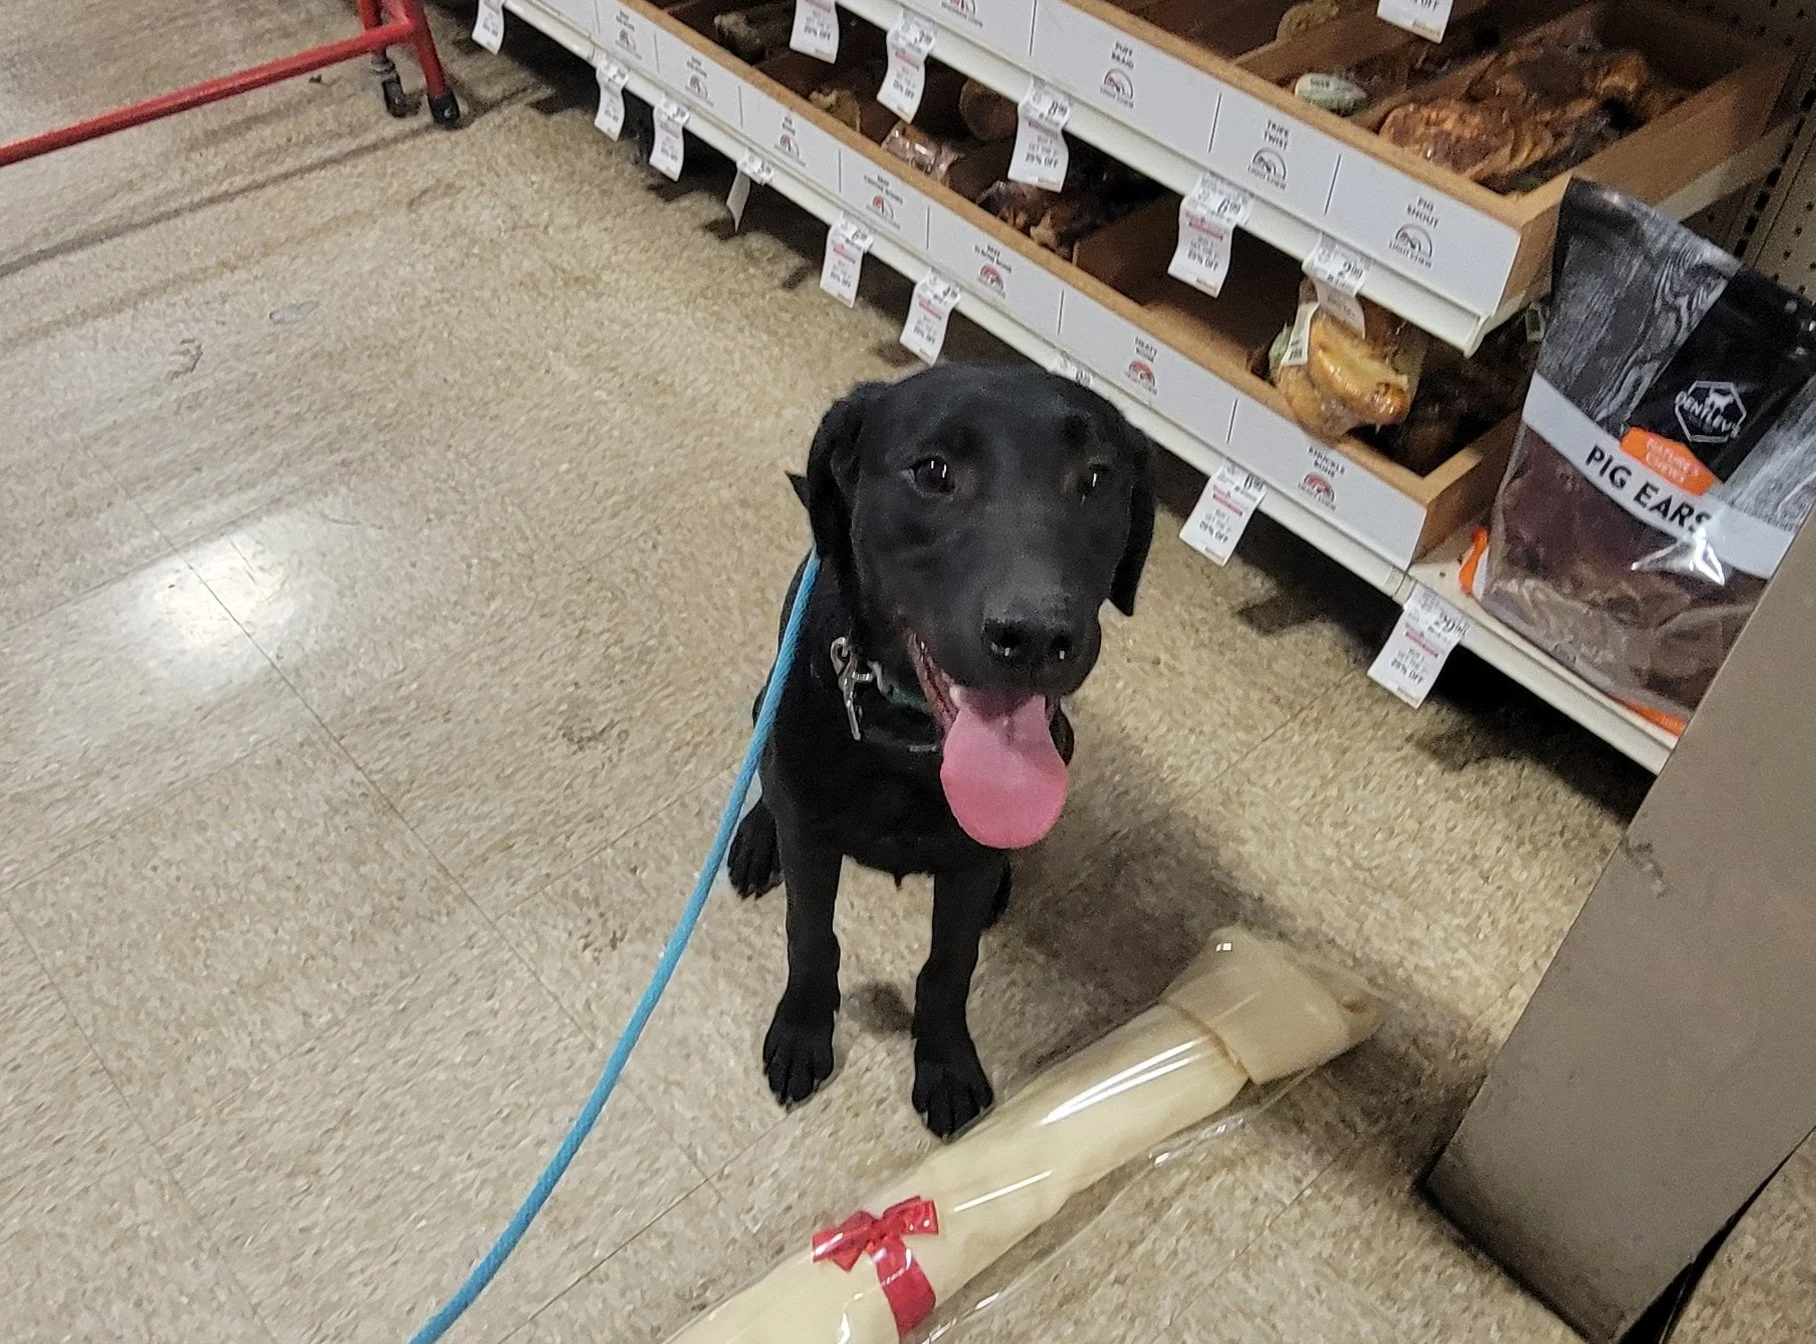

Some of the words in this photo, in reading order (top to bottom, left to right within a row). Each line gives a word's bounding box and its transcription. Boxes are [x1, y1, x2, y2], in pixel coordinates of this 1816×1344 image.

[1406, 205, 1440, 229] SNOUT
[1417, 196, 1435, 214] PIG
[1585, 444, 1633, 489] PIG
[1633, 481, 1712, 534] EARS
